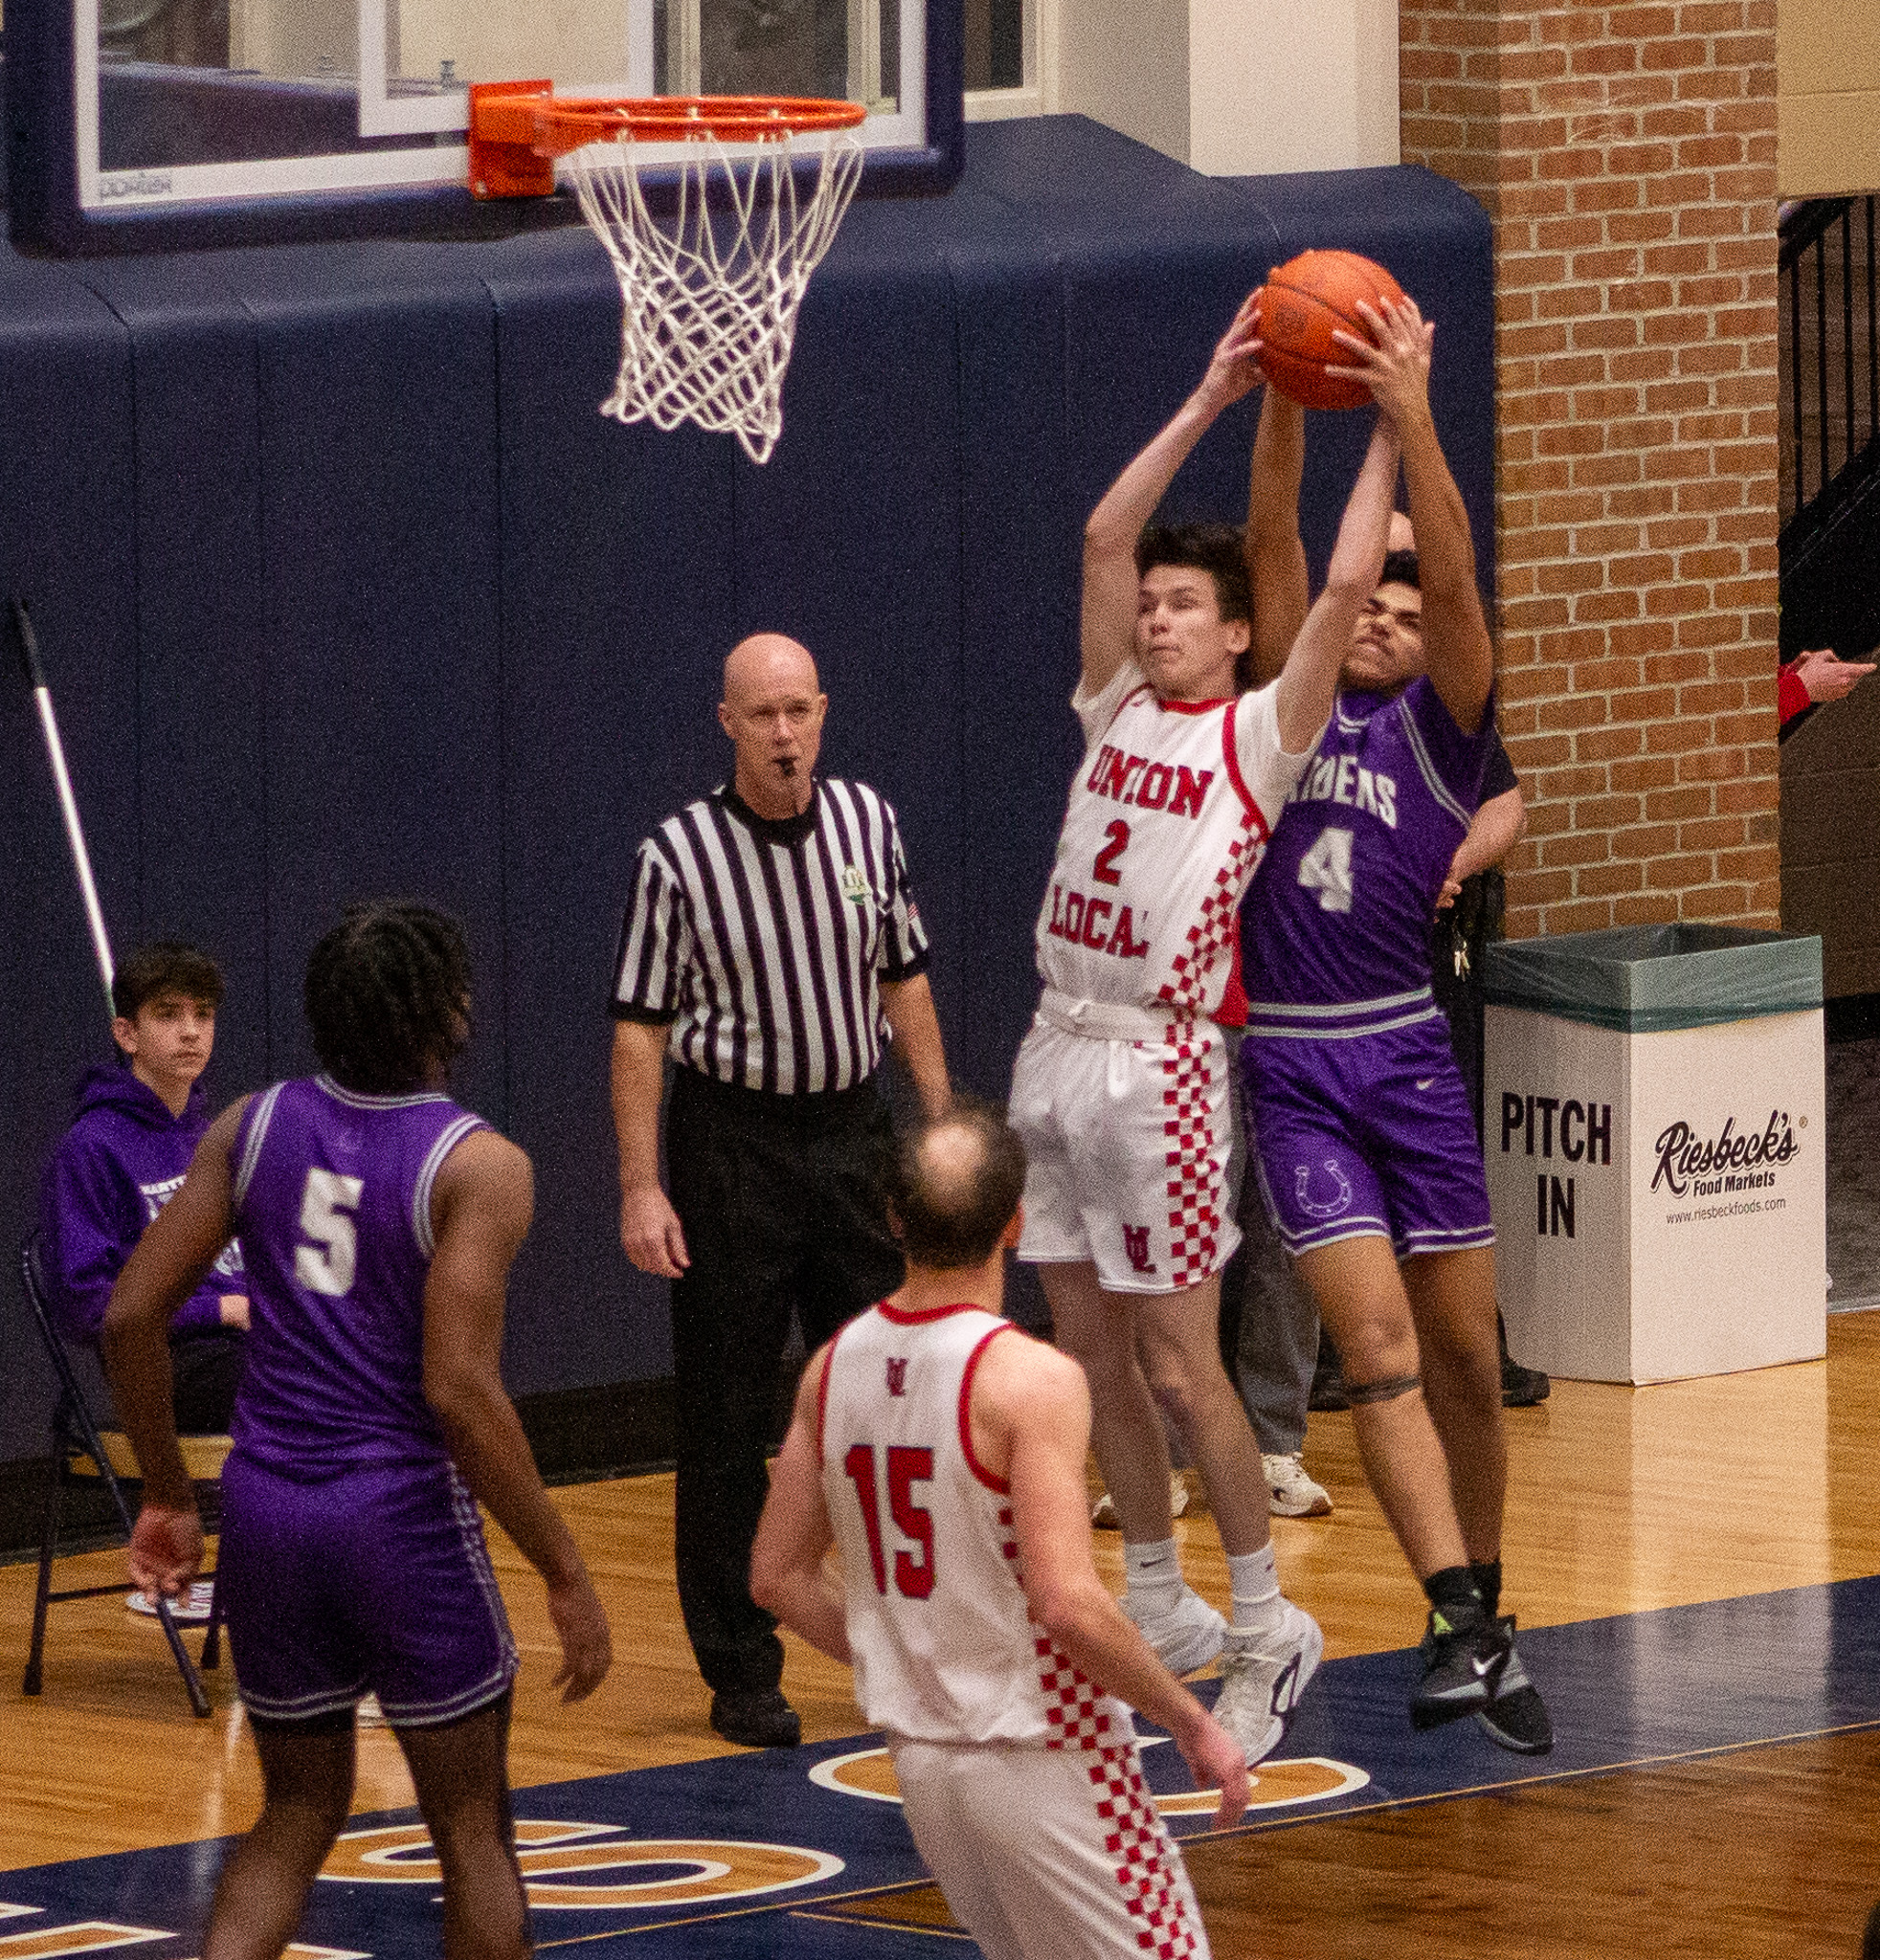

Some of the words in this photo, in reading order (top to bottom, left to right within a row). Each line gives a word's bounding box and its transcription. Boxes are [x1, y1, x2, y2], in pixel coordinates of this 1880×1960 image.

[1087, 744, 1214, 819] UNION
[1093, 819, 1131, 886] 2
[1297, 827, 1354, 913] 4
[1501, 1092, 1612, 1166] PITCH
[1650, 1109, 1800, 1197] Riesbeck's
[1537, 1174, 1576, 1238] IN
[1666, 1198, 1786, 1225] www.riesbeckfoods.com
[1693, 1177, 1723, 1197] Food
[1724, 1171, 1776, 1193] Markets
[295, 1166, 365, 1297] 5
[844, 1444, 936, 1599] 15
